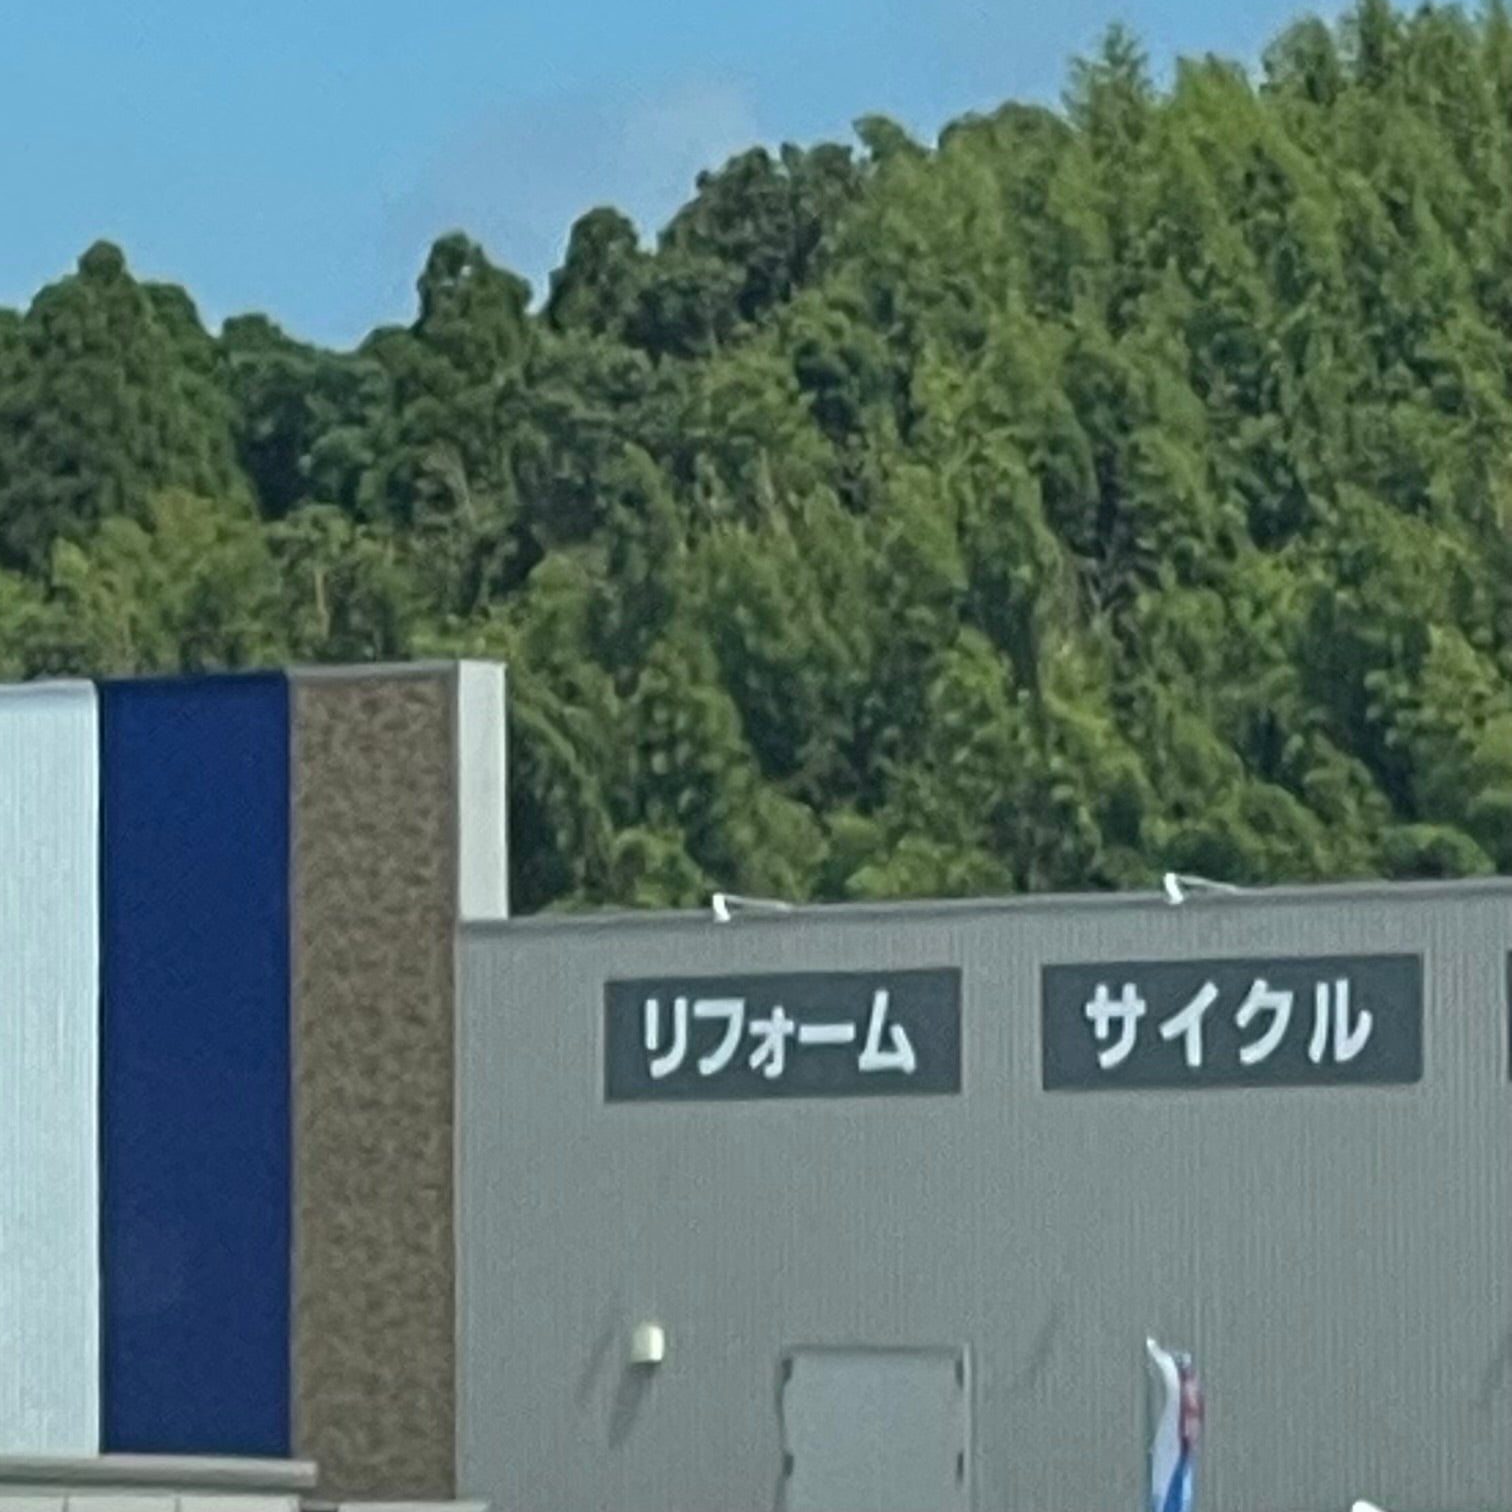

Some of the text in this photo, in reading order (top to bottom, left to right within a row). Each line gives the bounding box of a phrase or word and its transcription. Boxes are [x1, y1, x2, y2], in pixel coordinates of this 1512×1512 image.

[644, 987, 918, 1079] リフォーム
[1085, 977, 1373, 1070] サイクル
